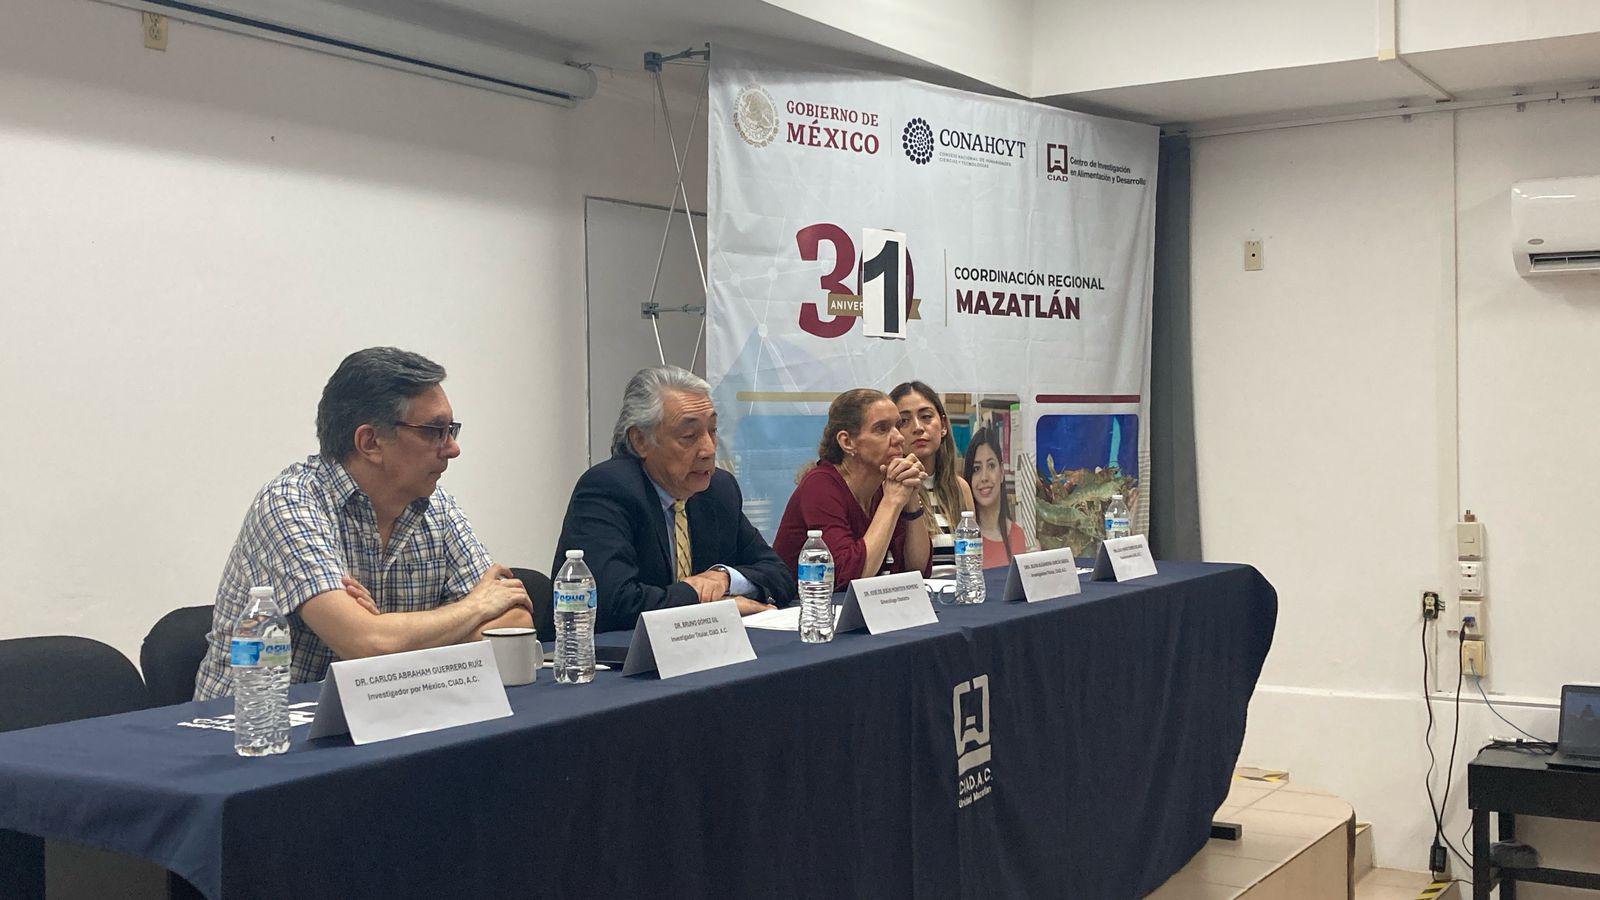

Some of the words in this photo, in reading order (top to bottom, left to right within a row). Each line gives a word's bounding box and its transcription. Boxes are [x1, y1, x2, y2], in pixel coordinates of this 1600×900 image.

[786, 100, 858, 123] GOBIERNO
[861, 112, 879, 127] DE
[786, 119, 880, 155] MÉXICO
[939, 128, 1026, 159] CONAHCYT
[1069, 156, 1088, 167] Centro
[1089, 160, 1097, 168] de
[1097, 161, 1131, 174] Investigación
[1077, 169, 1111, 182] Alimentación
[1111, 176, 1115, 184] y
[1116, 175, 1147, 186] Desarrollo
[1047, 174, 1069, 182] CIAD
[954, 266, 1045, 286] COORDINACIÓN
[1048, 274, 1105, 290] REGIONAL
[956, 289, 1081, 320] MAZATLÁN
[355, 677, 369, 687] DR.
[369, 672, 398, 685] CARLOS
[398, 667, 431, 681] ABRAHAM
[432, 662, 467, 676] GUERRERO
[367, 687, 409, 701] Investigador
[410, 686, 421, 696] por
[422, 681, 447, 692] México,
[448, 678, 466, 688] CIAD,
[466, 675, 480, 685] A.C.
